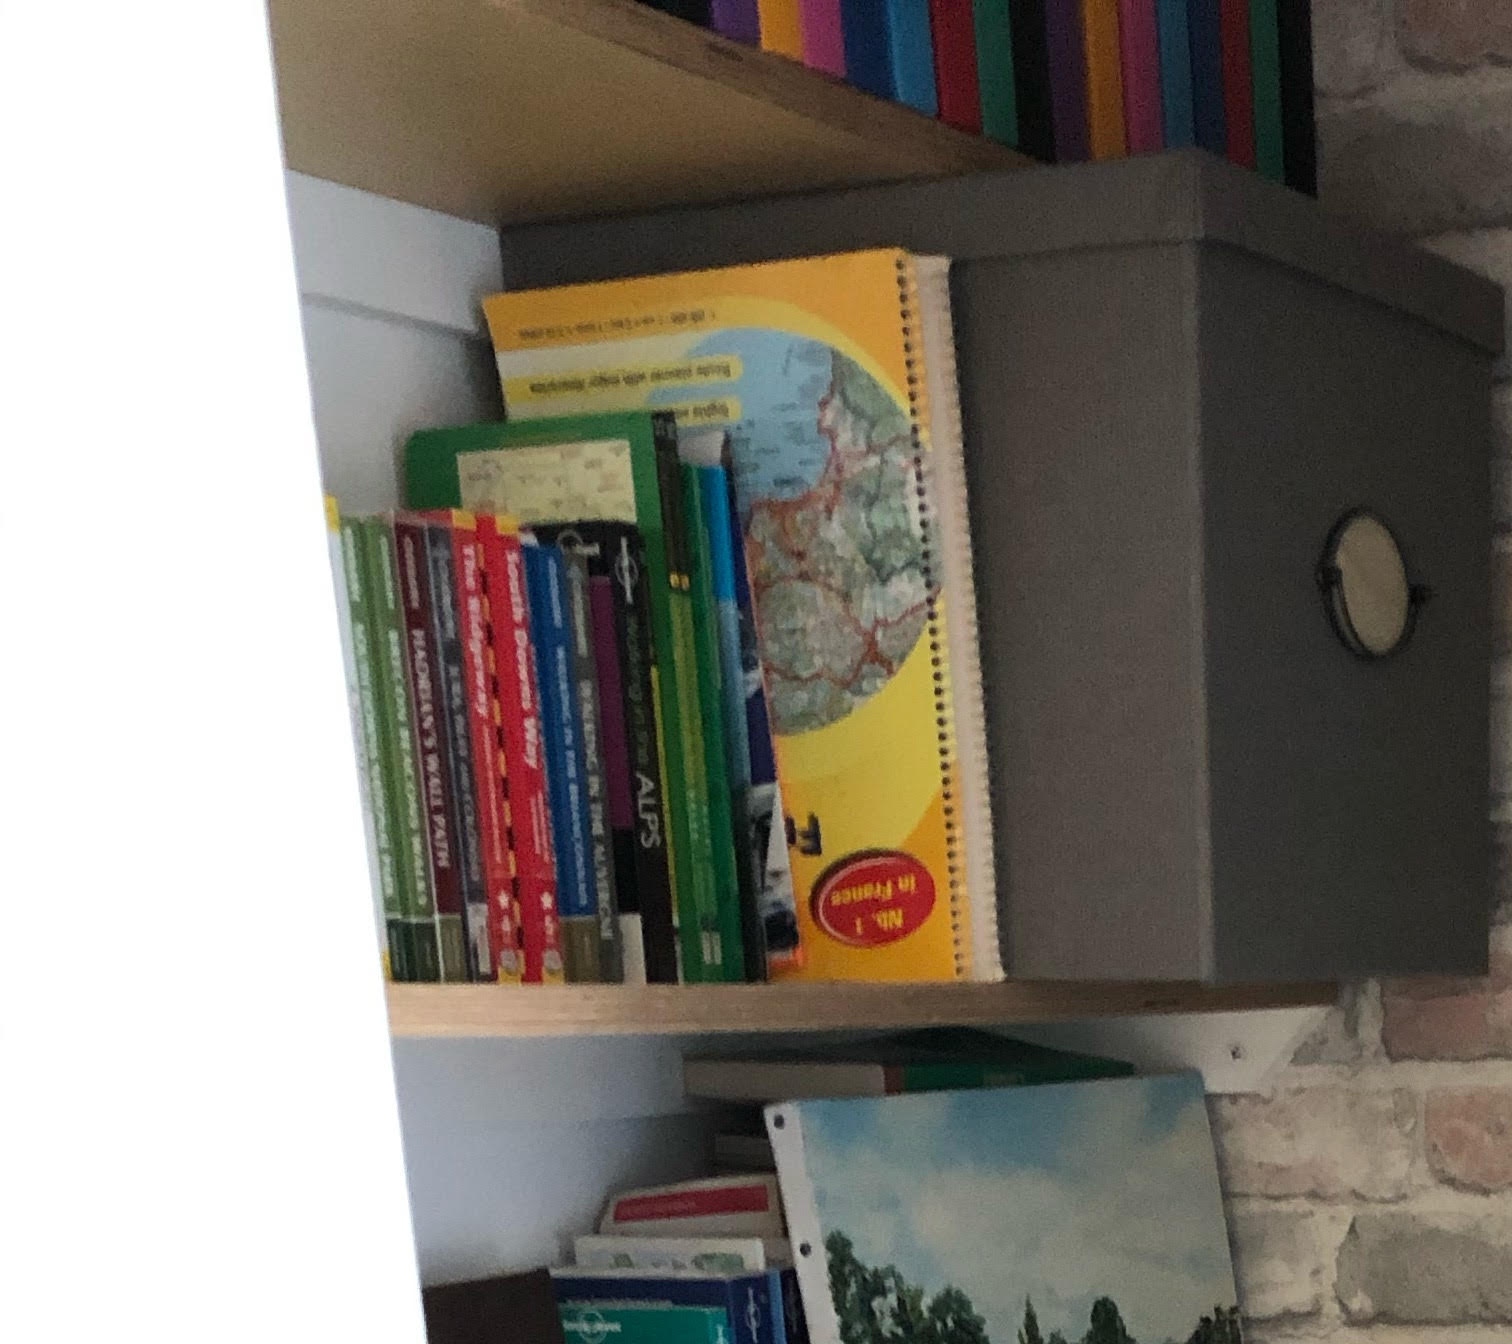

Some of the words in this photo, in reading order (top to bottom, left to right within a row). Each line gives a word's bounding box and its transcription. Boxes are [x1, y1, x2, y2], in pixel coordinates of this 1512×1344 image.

[462, 544, 477, 591] The
[504, 548, 526, 623] South
[465, 595, 489, 719] Ridgeway
[513, 627, 536, 710] Downs
[409, 628, 437, 749] HADRIAN'S
[519, 715, 541, 769] Way
[564, 749, 578, 779] THE
[424, 753, 444, 806] WALL
[586, 773, 601, 797] IN
[589, 802, 605, 835] THE
[634, 770, 661, 849] ALPS
[431, 813, 452, 869] PATH
[830, 880, 893, 907] France
[897, 873, 917, 895] in
